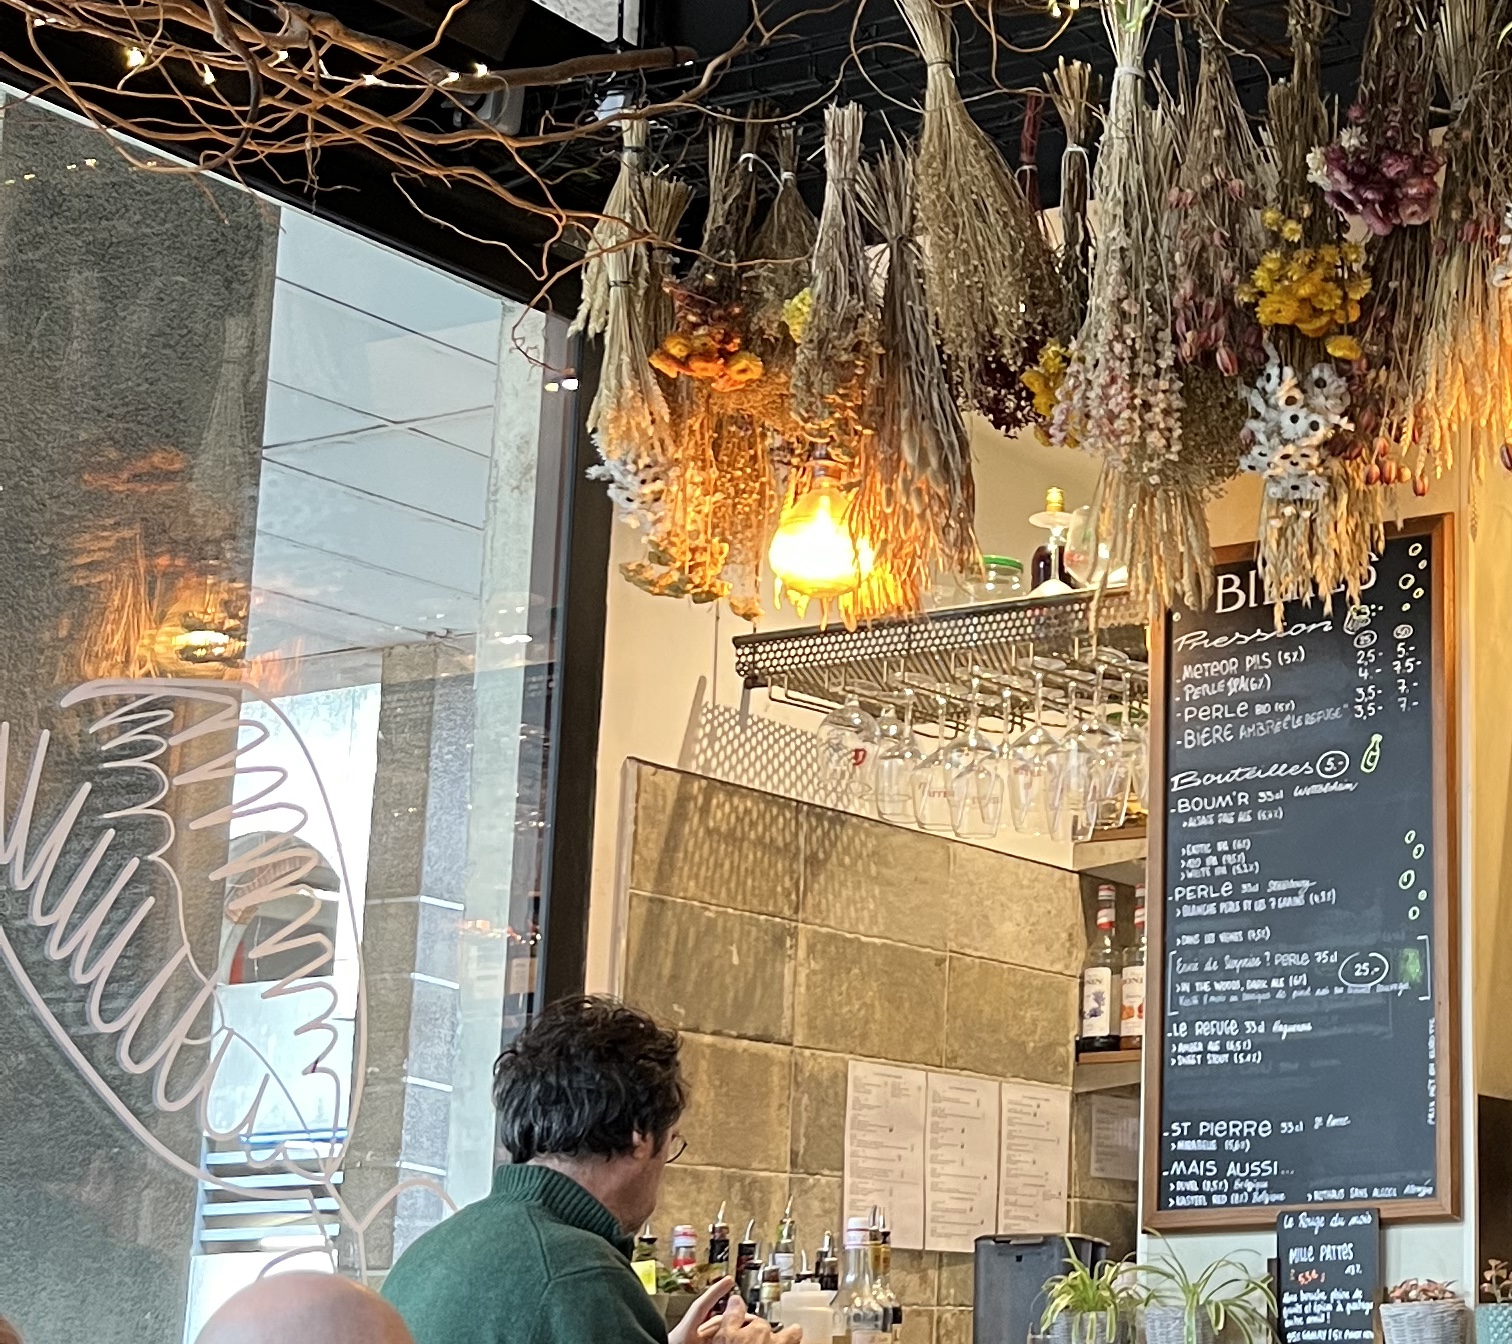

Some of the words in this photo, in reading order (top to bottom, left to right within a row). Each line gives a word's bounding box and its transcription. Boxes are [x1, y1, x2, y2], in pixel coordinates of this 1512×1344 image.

[1215, 550, 1379, 614] BIS
[1173, 621, 1333, 652] Pression
[1182, 657, 1239, 681] METEOR
[1245, 652, 1272, 672] PILS
[1183, 679, 1225, 702] PERLE
[1184, 701, 1249, 722] PERLE
[1170, 761, 1314, 792] Bouteilles
[1177, 790, 1250, 813] BOUM'R
[1174, 881, 1233, 902] PERLE
[1203, 957, 1219, 972] de
[1274, 952, 1311, 967] PERLE
[1173, 1022, 1187, 1037] LE
[1195, 1019, 1240, 1036] REFUGE
[1171, 1122, 1191, 1137] ST
[1199, 1120, 1273, 1137] PIERRE
[1170, 1160, 1218, 1176] MAIS
[1330, 1213, 1346, 1227] du
[1289, 1244, 1315, 1265] MILLE
[1319, 1242, 1354, 1262] PATTES
